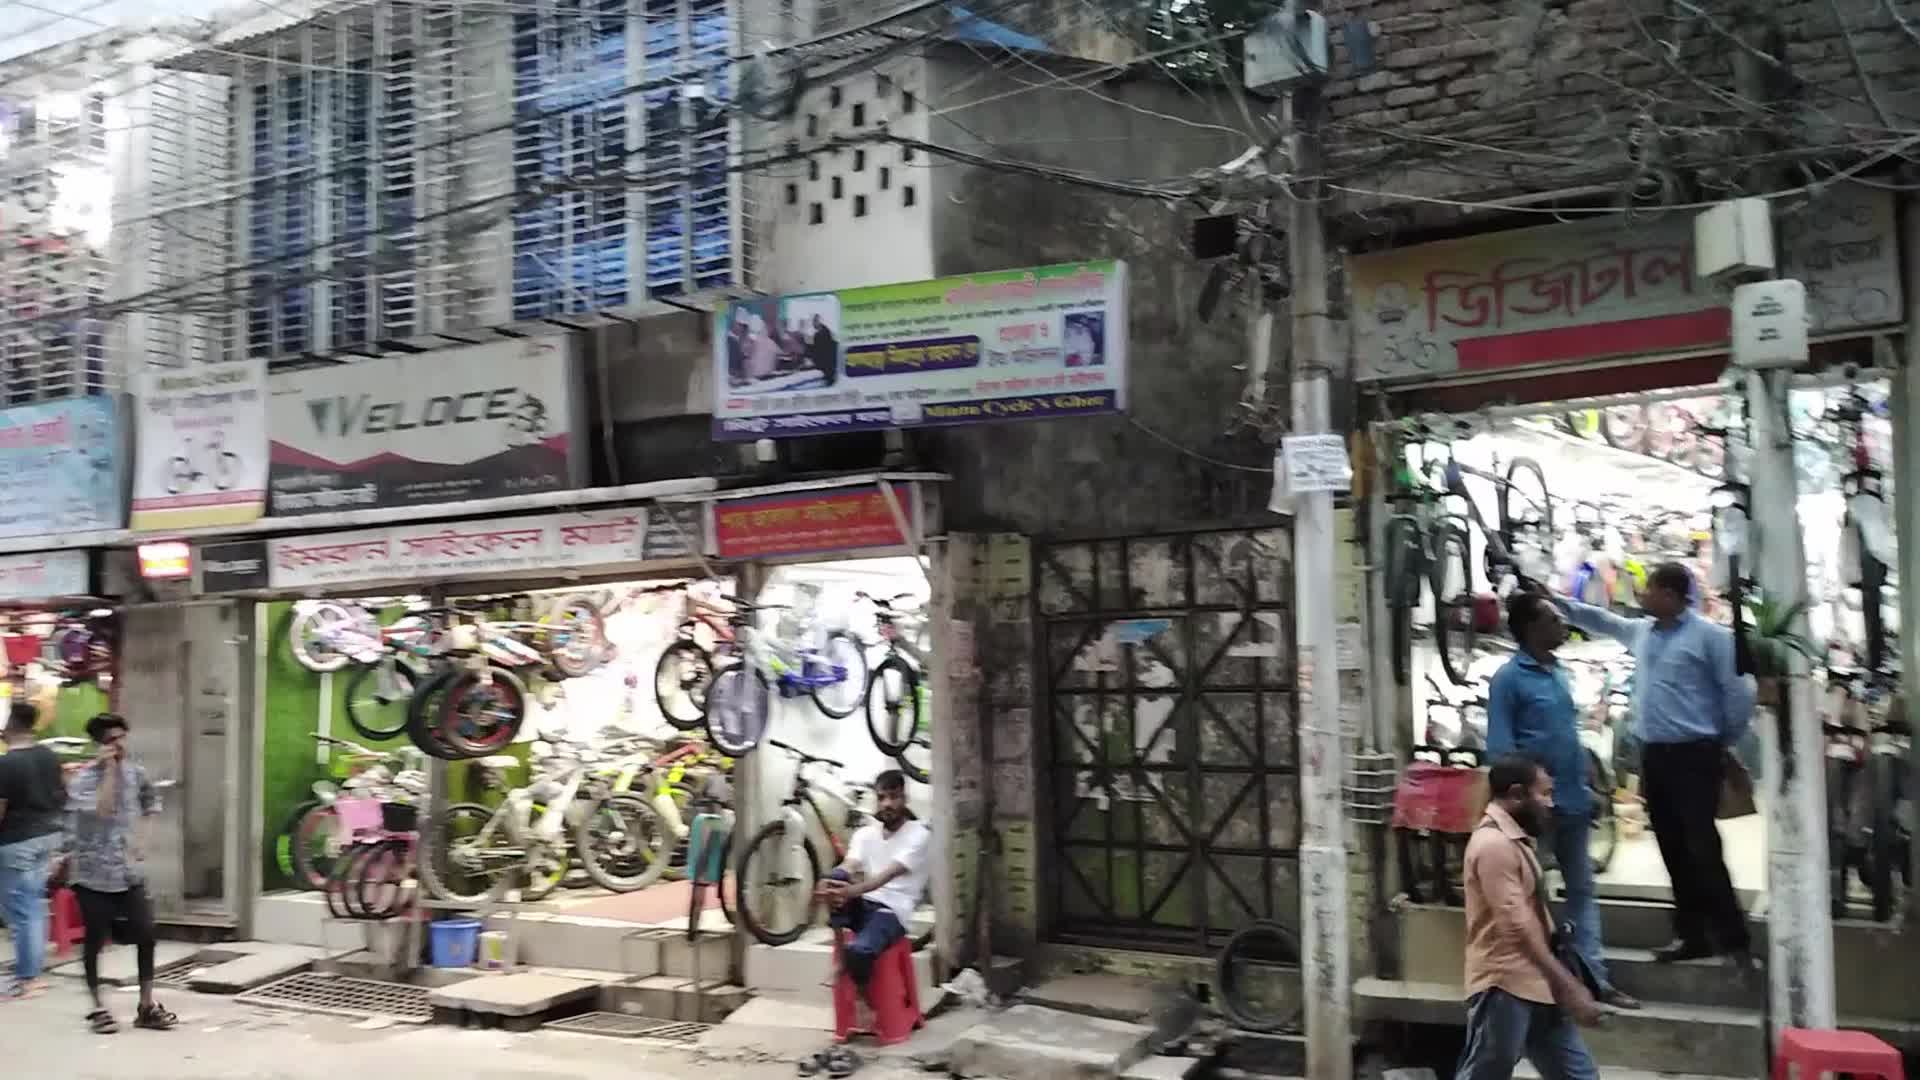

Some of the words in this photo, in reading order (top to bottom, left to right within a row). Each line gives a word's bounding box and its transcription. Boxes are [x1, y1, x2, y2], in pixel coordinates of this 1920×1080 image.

[1421, 241, 1693, 332] ডিজিটাল
[337, 387, 517, 435] VELOCE
[400, 529, 544, 557] সাইকেল
